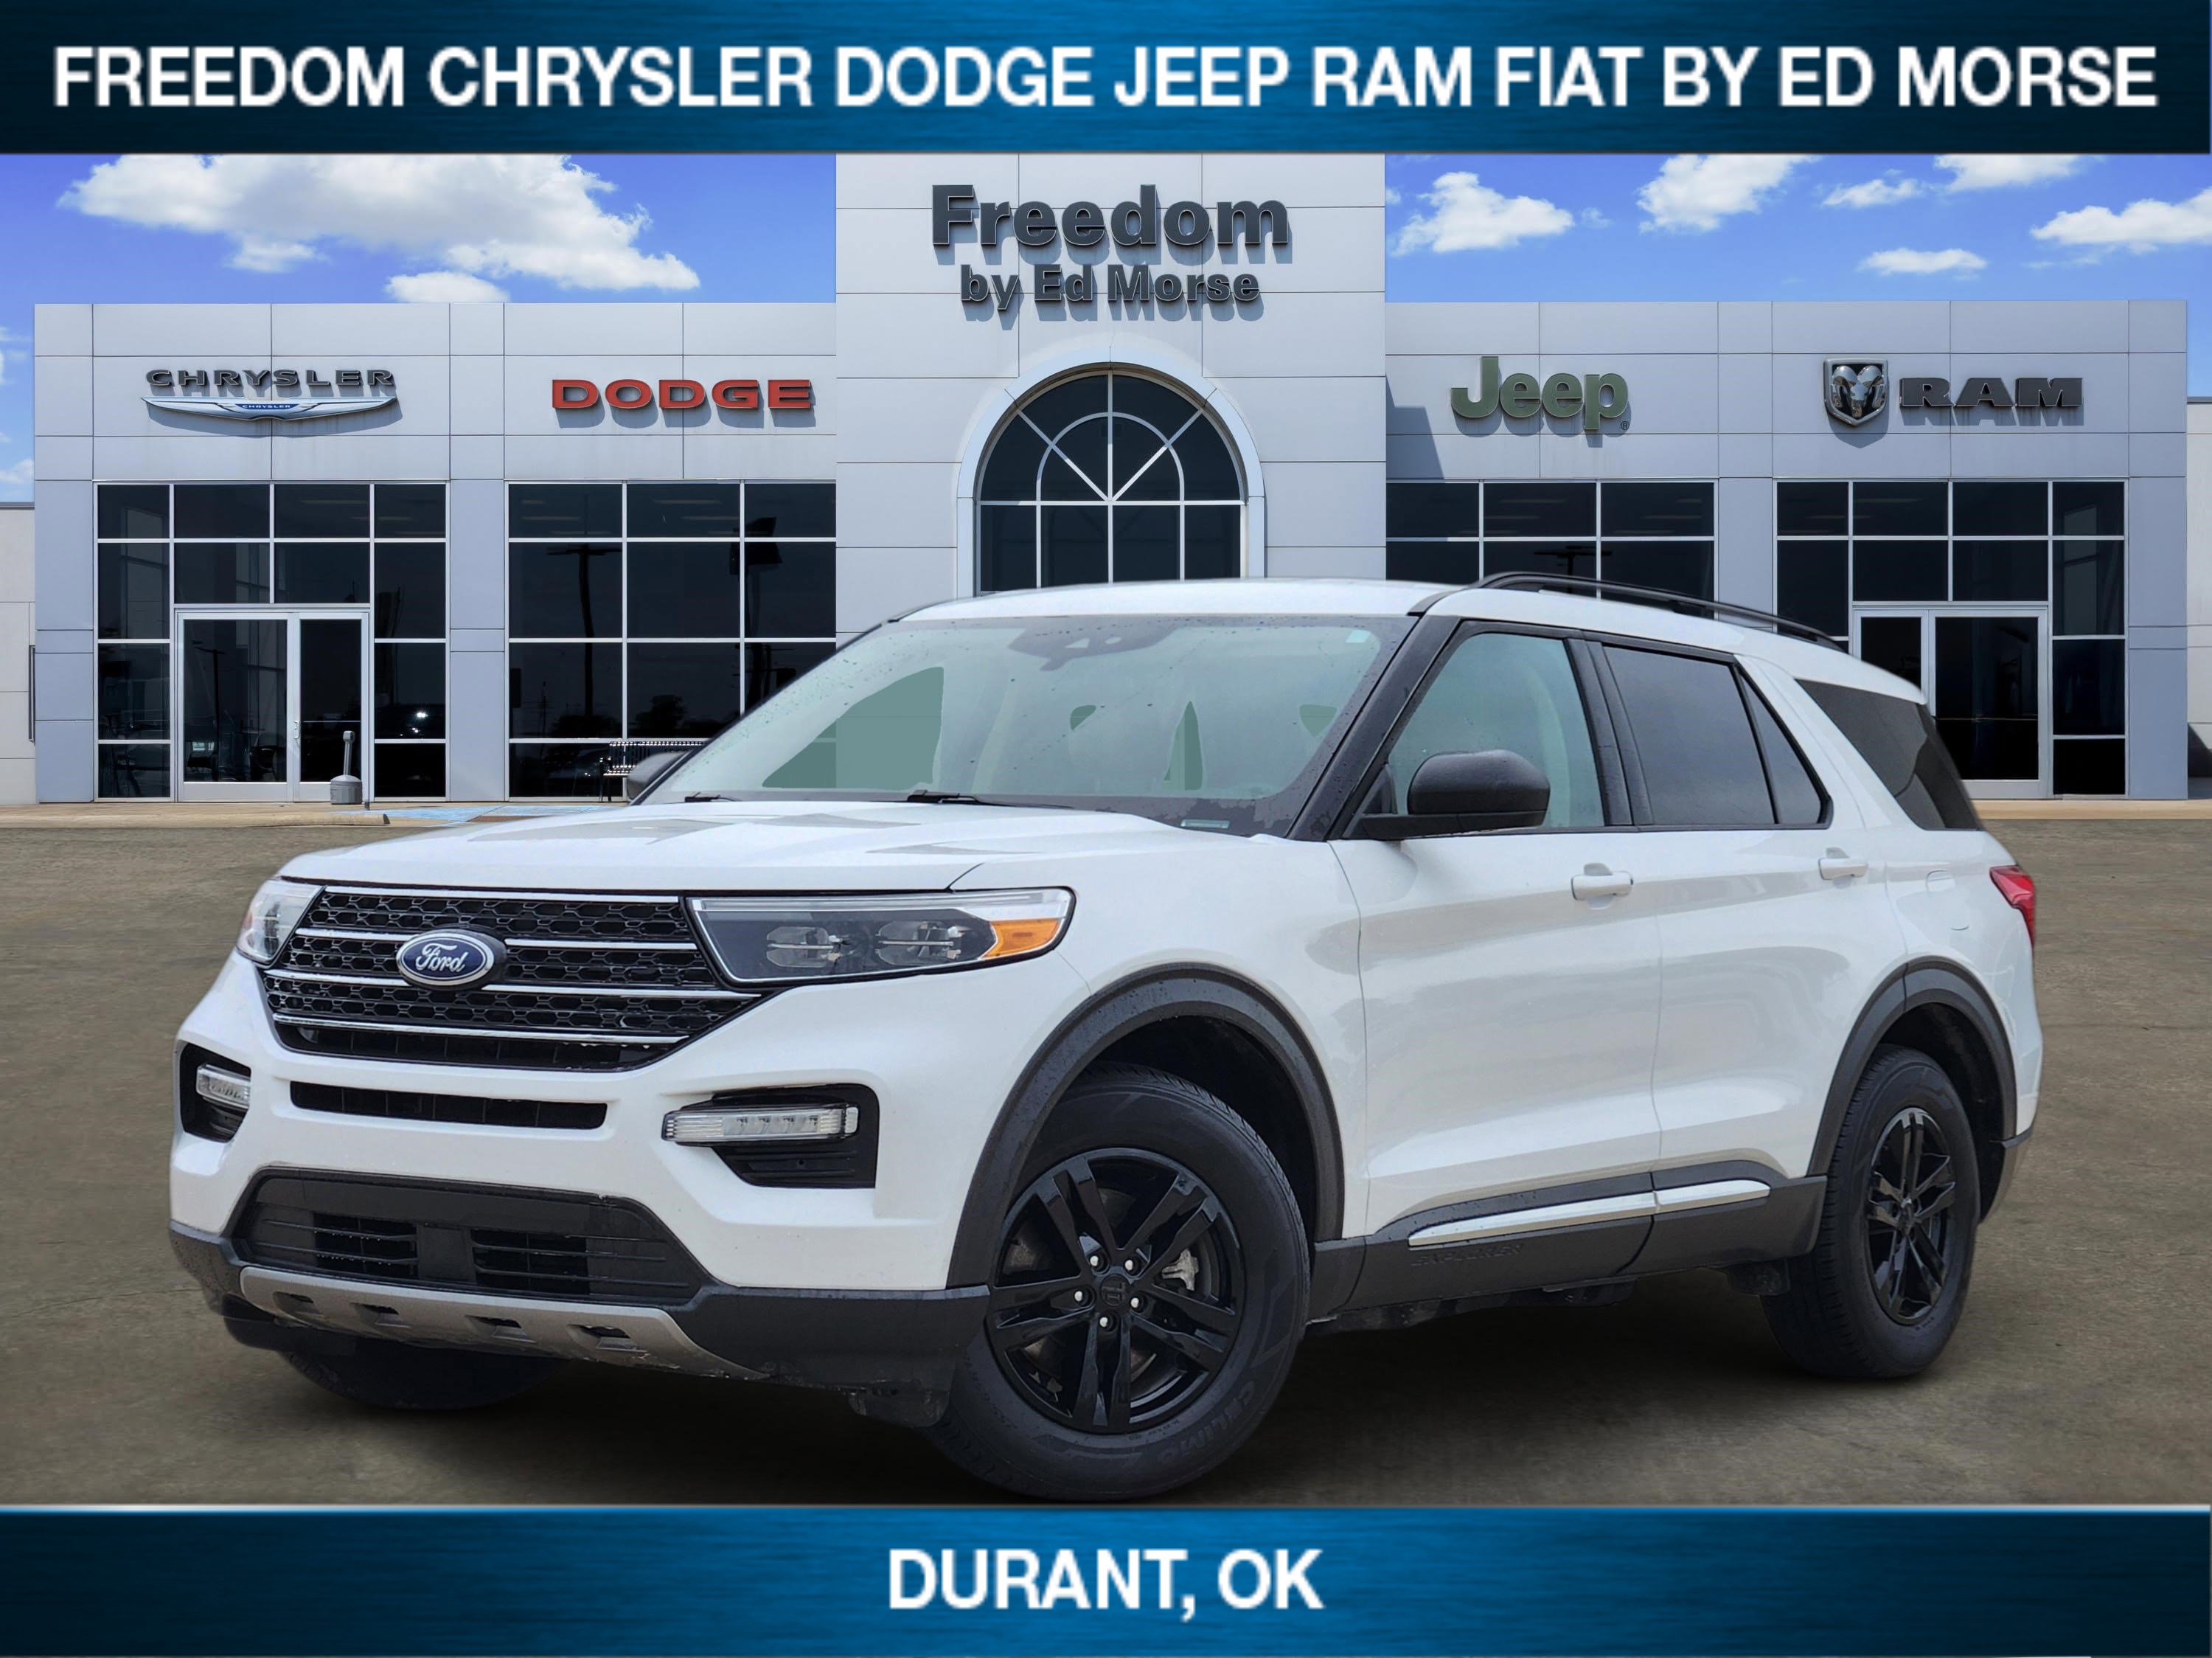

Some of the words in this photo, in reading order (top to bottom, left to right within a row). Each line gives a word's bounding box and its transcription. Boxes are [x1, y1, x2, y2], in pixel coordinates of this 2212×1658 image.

[932, 184, 1288, 246] Freedom
[961, 264, 1020, 311] by
[1034, 264, 1093, 301] Ed
[1107, 264, 1260, 302] Morse
[146, 369, 394, 387] CHRYSLER
[1450, 356, 1629, 430] Jeep
[1899, 378, 2084, 407] RAM
[552, 379, 811, 409] DODGE
[415, 943, 469, 973] Ford
